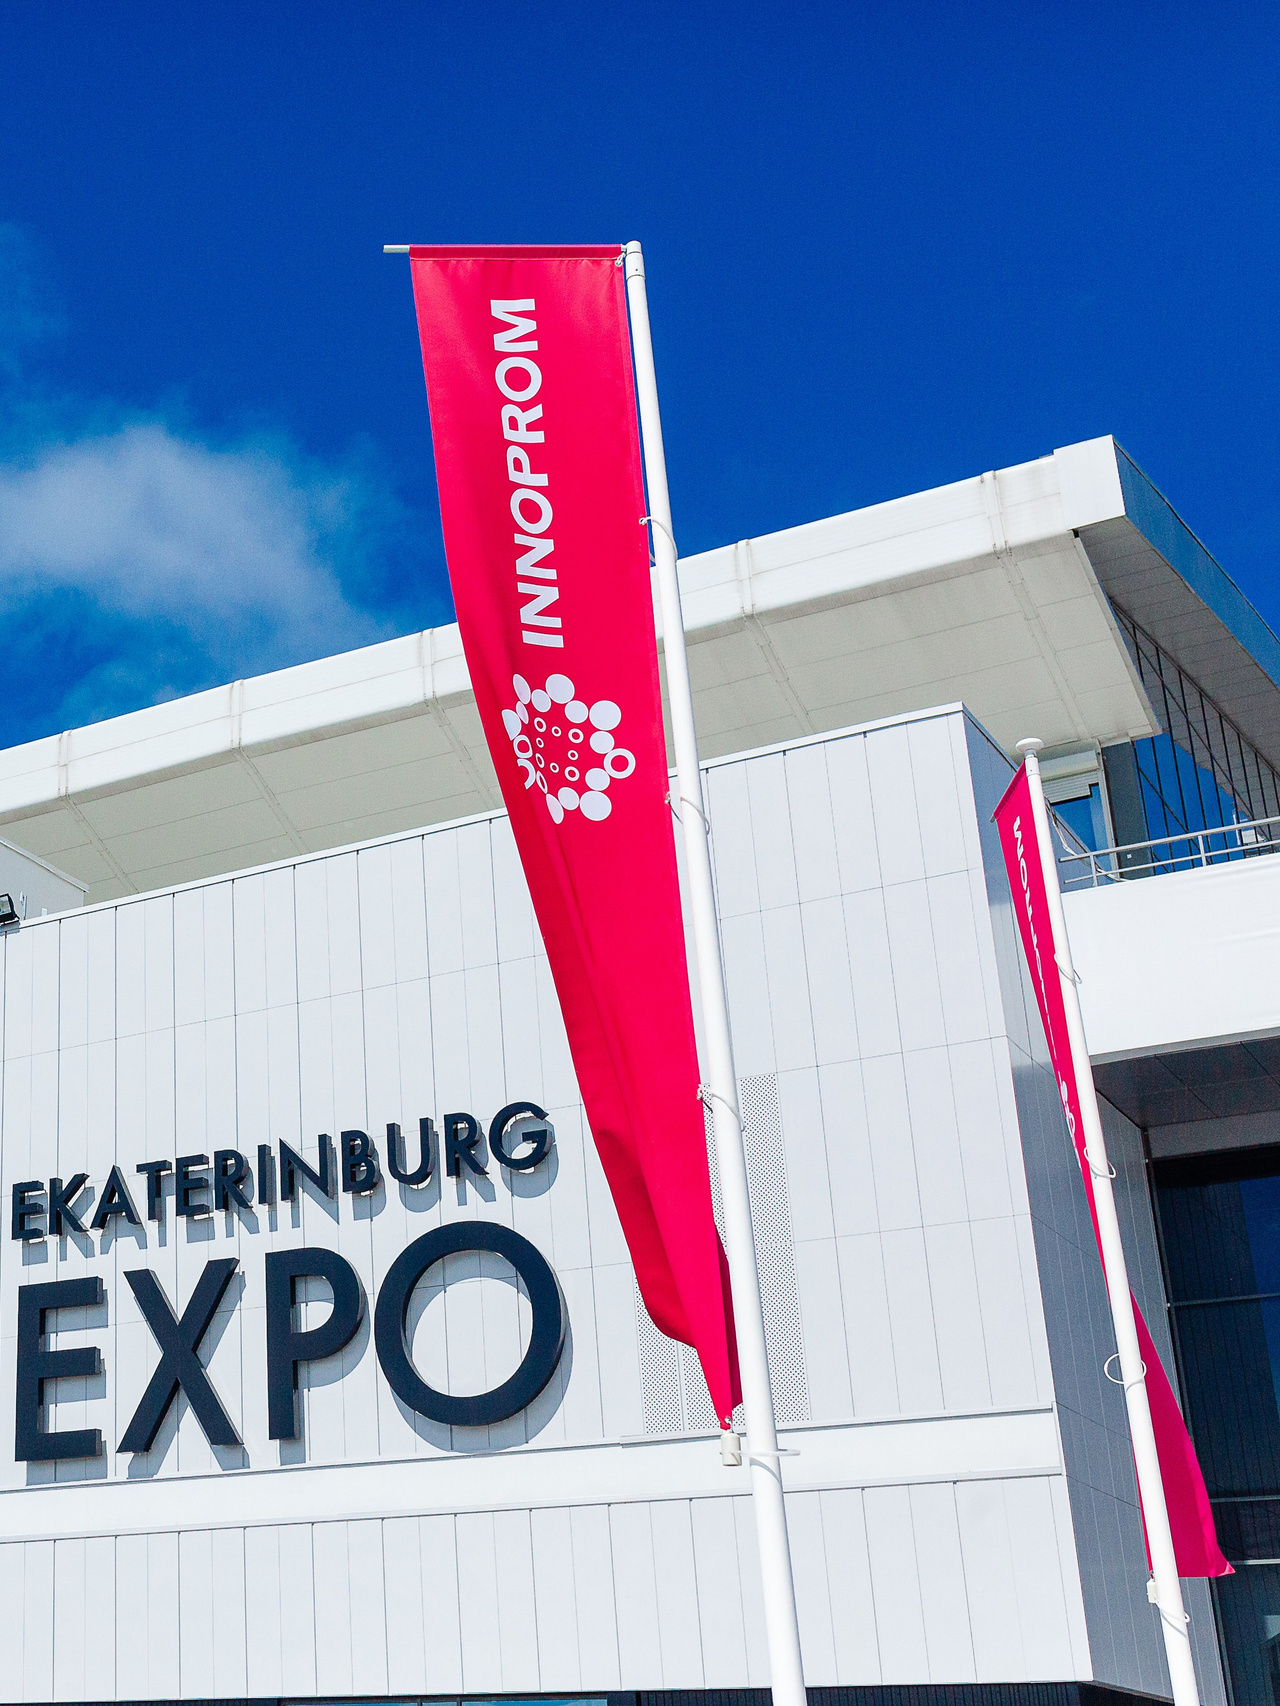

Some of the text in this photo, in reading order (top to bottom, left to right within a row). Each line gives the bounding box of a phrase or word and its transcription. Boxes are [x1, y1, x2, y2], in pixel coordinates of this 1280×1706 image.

[490, 298, 565, 648] INNOPROM
[11, 1101, 554, 1241] EKATERINBURG
[15, 1220, 567, 1462] EXPO
